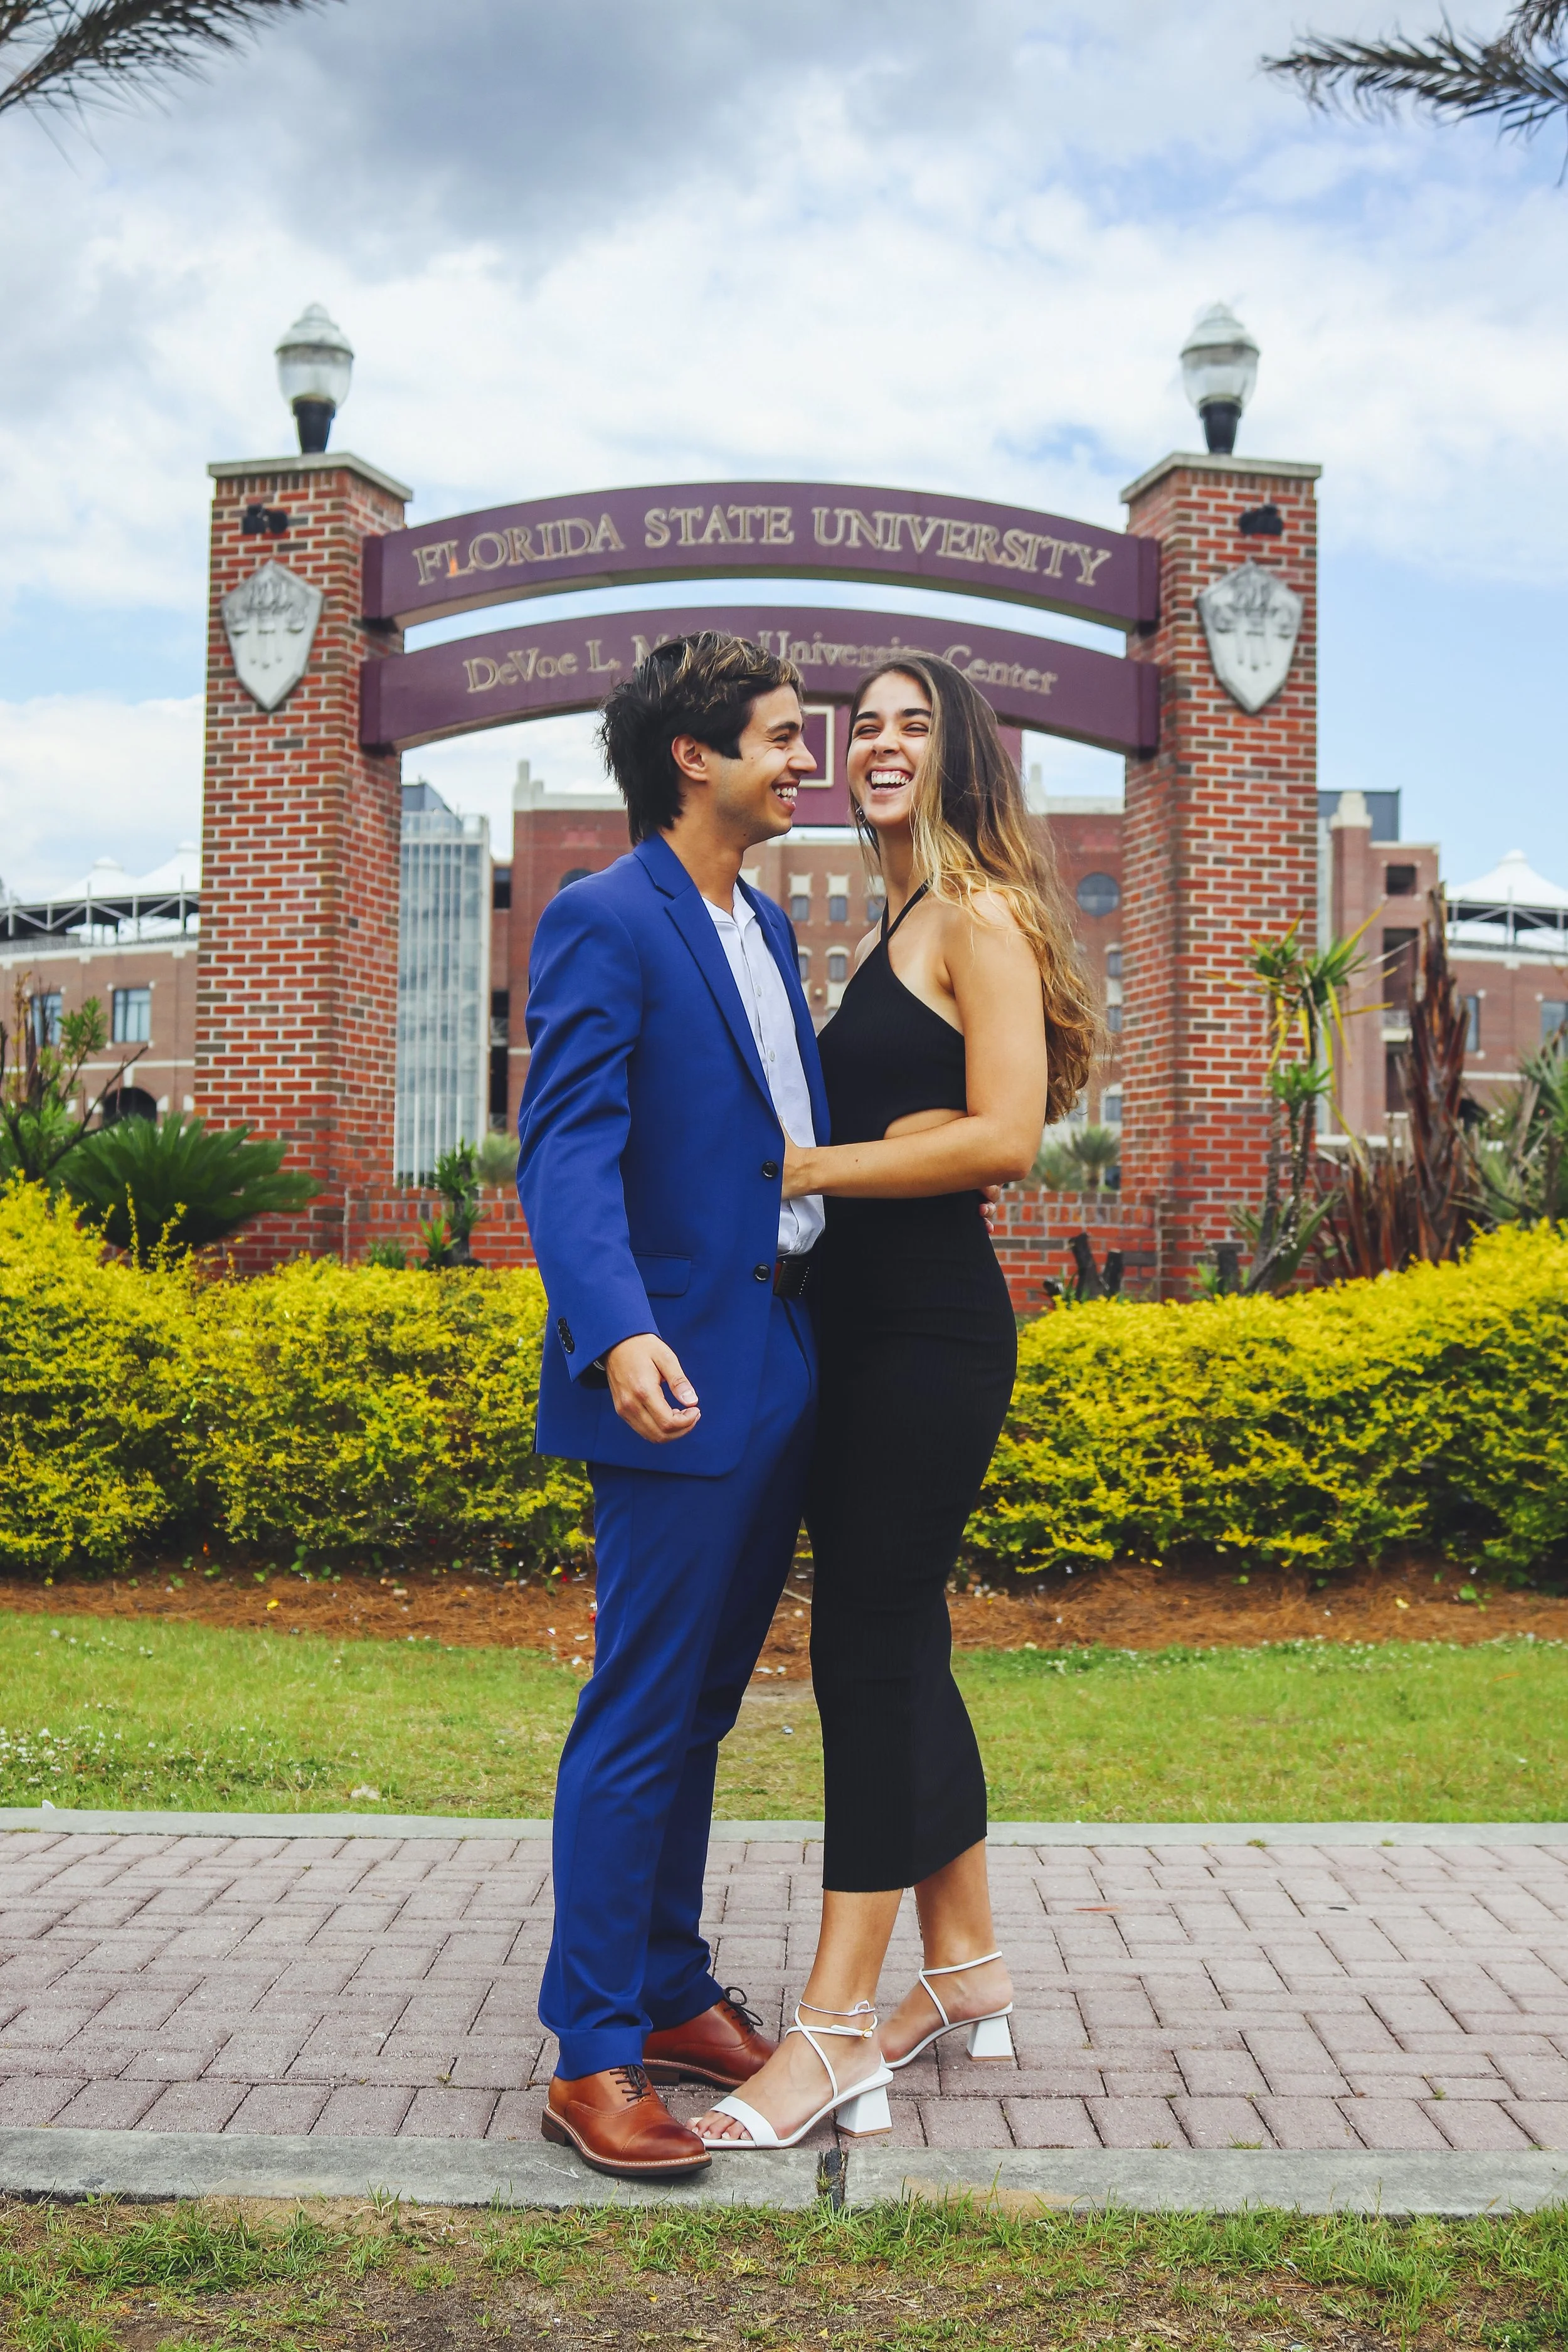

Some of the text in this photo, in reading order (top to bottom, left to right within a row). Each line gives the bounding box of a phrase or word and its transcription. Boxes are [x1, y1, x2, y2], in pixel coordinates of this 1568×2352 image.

[413, 505, 1111, 586] FLORIDA STATE UNIVERSITY
[463, 647, 578, 693] DeVoe
[586, 639, 620, 673] L.
[758, 630, 919, 667] Universi
[943, 645, 1058, 694] Center
